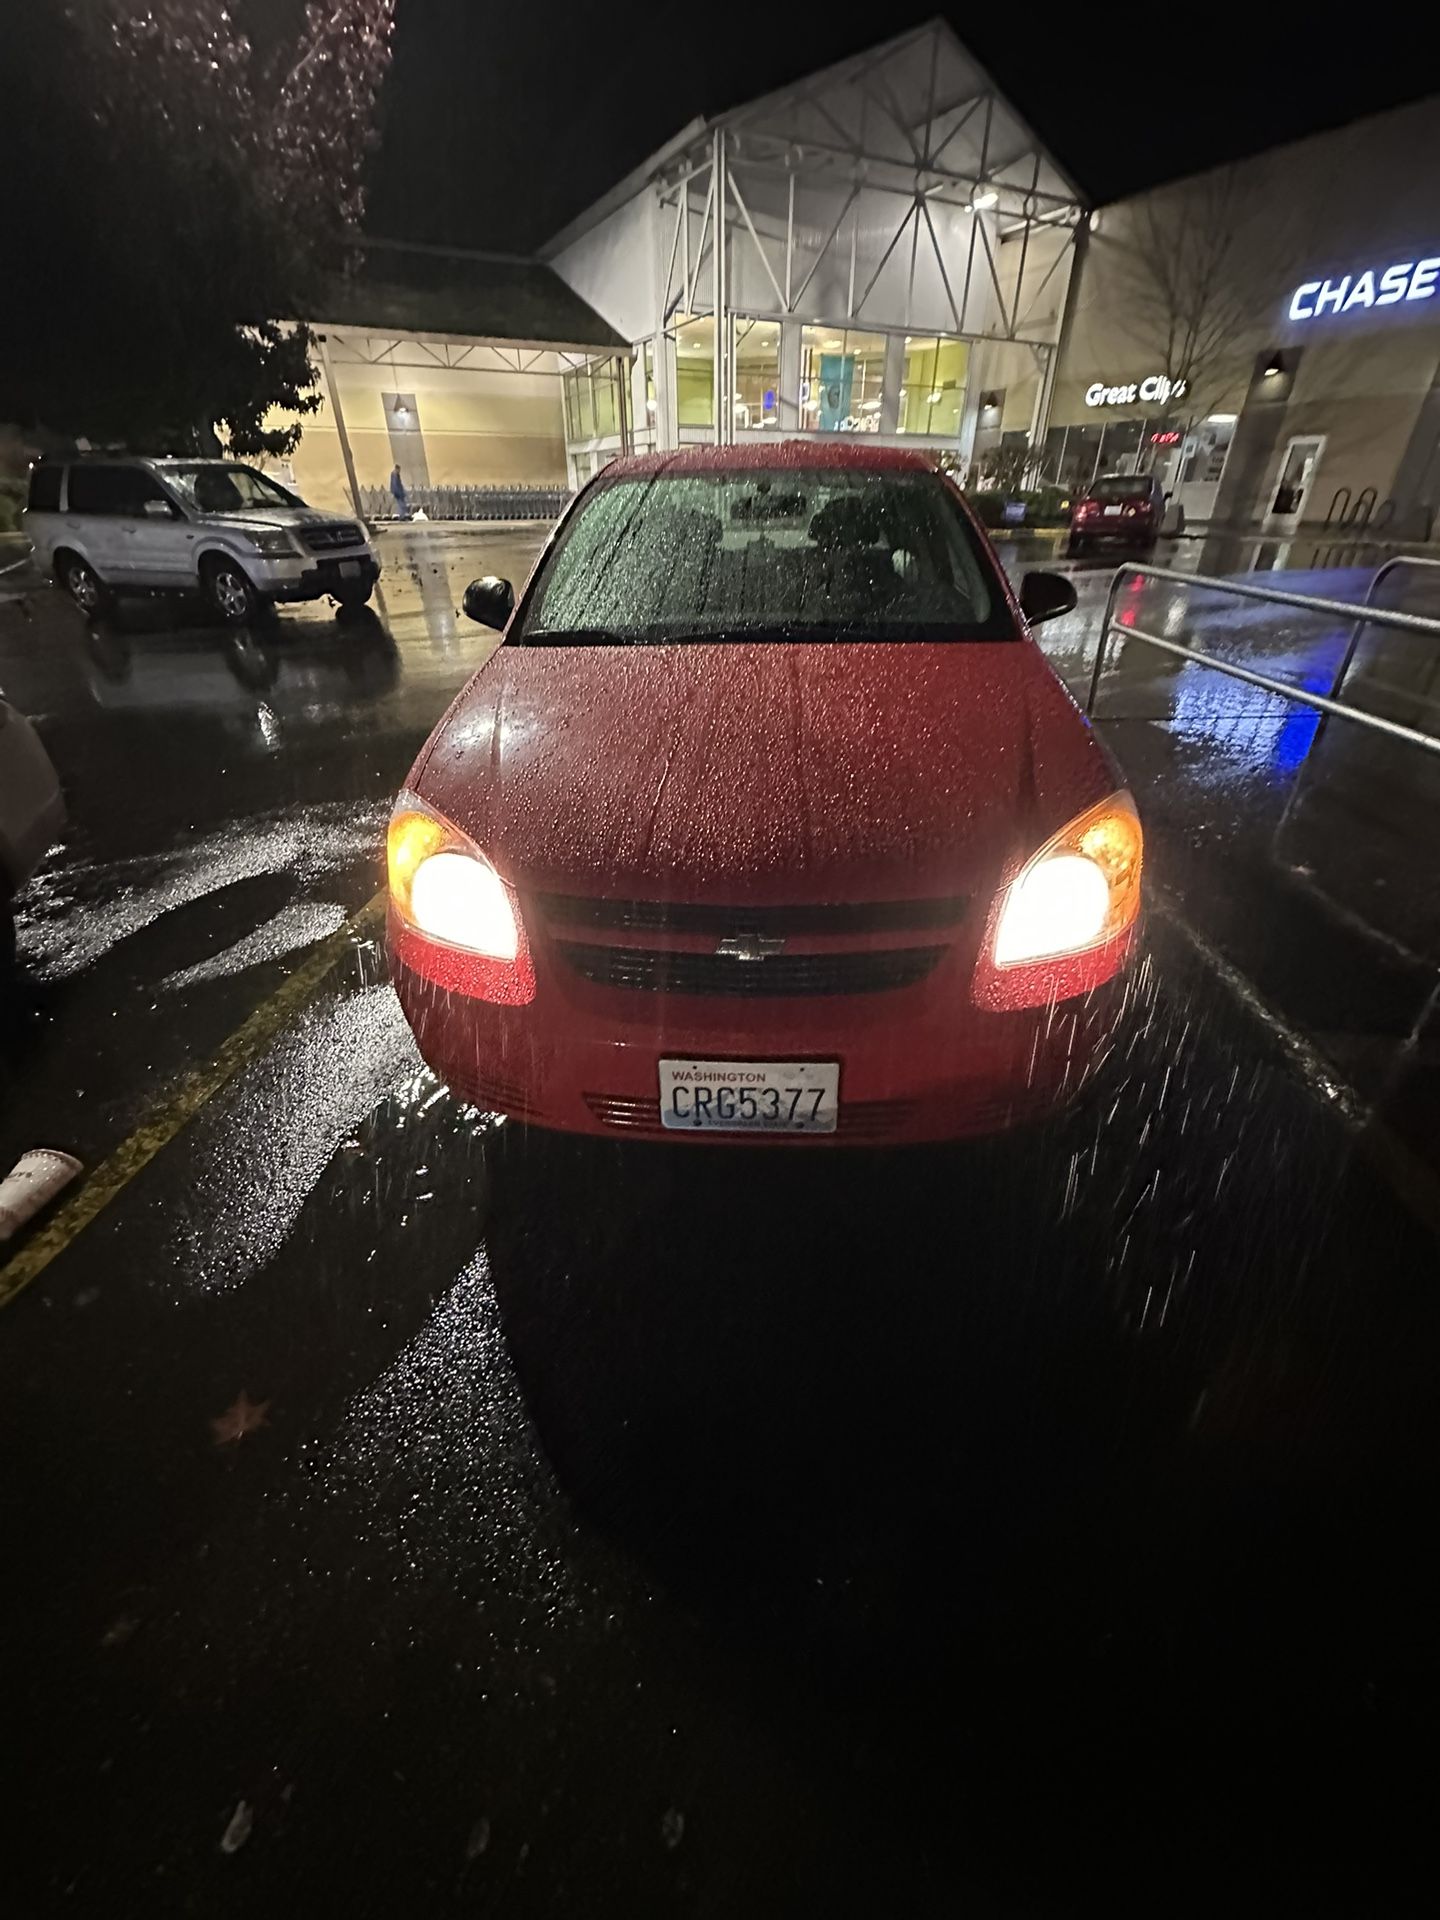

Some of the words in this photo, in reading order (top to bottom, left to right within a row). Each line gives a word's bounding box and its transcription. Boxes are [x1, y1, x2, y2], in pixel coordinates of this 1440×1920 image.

[1289, 257, 1440, 321] CHASE
[1085, 383, 1138, 406] Great
[672, 1071, 767, 1083] WASHINGTON
[672, 1086, 826, 1121] CRG5377
